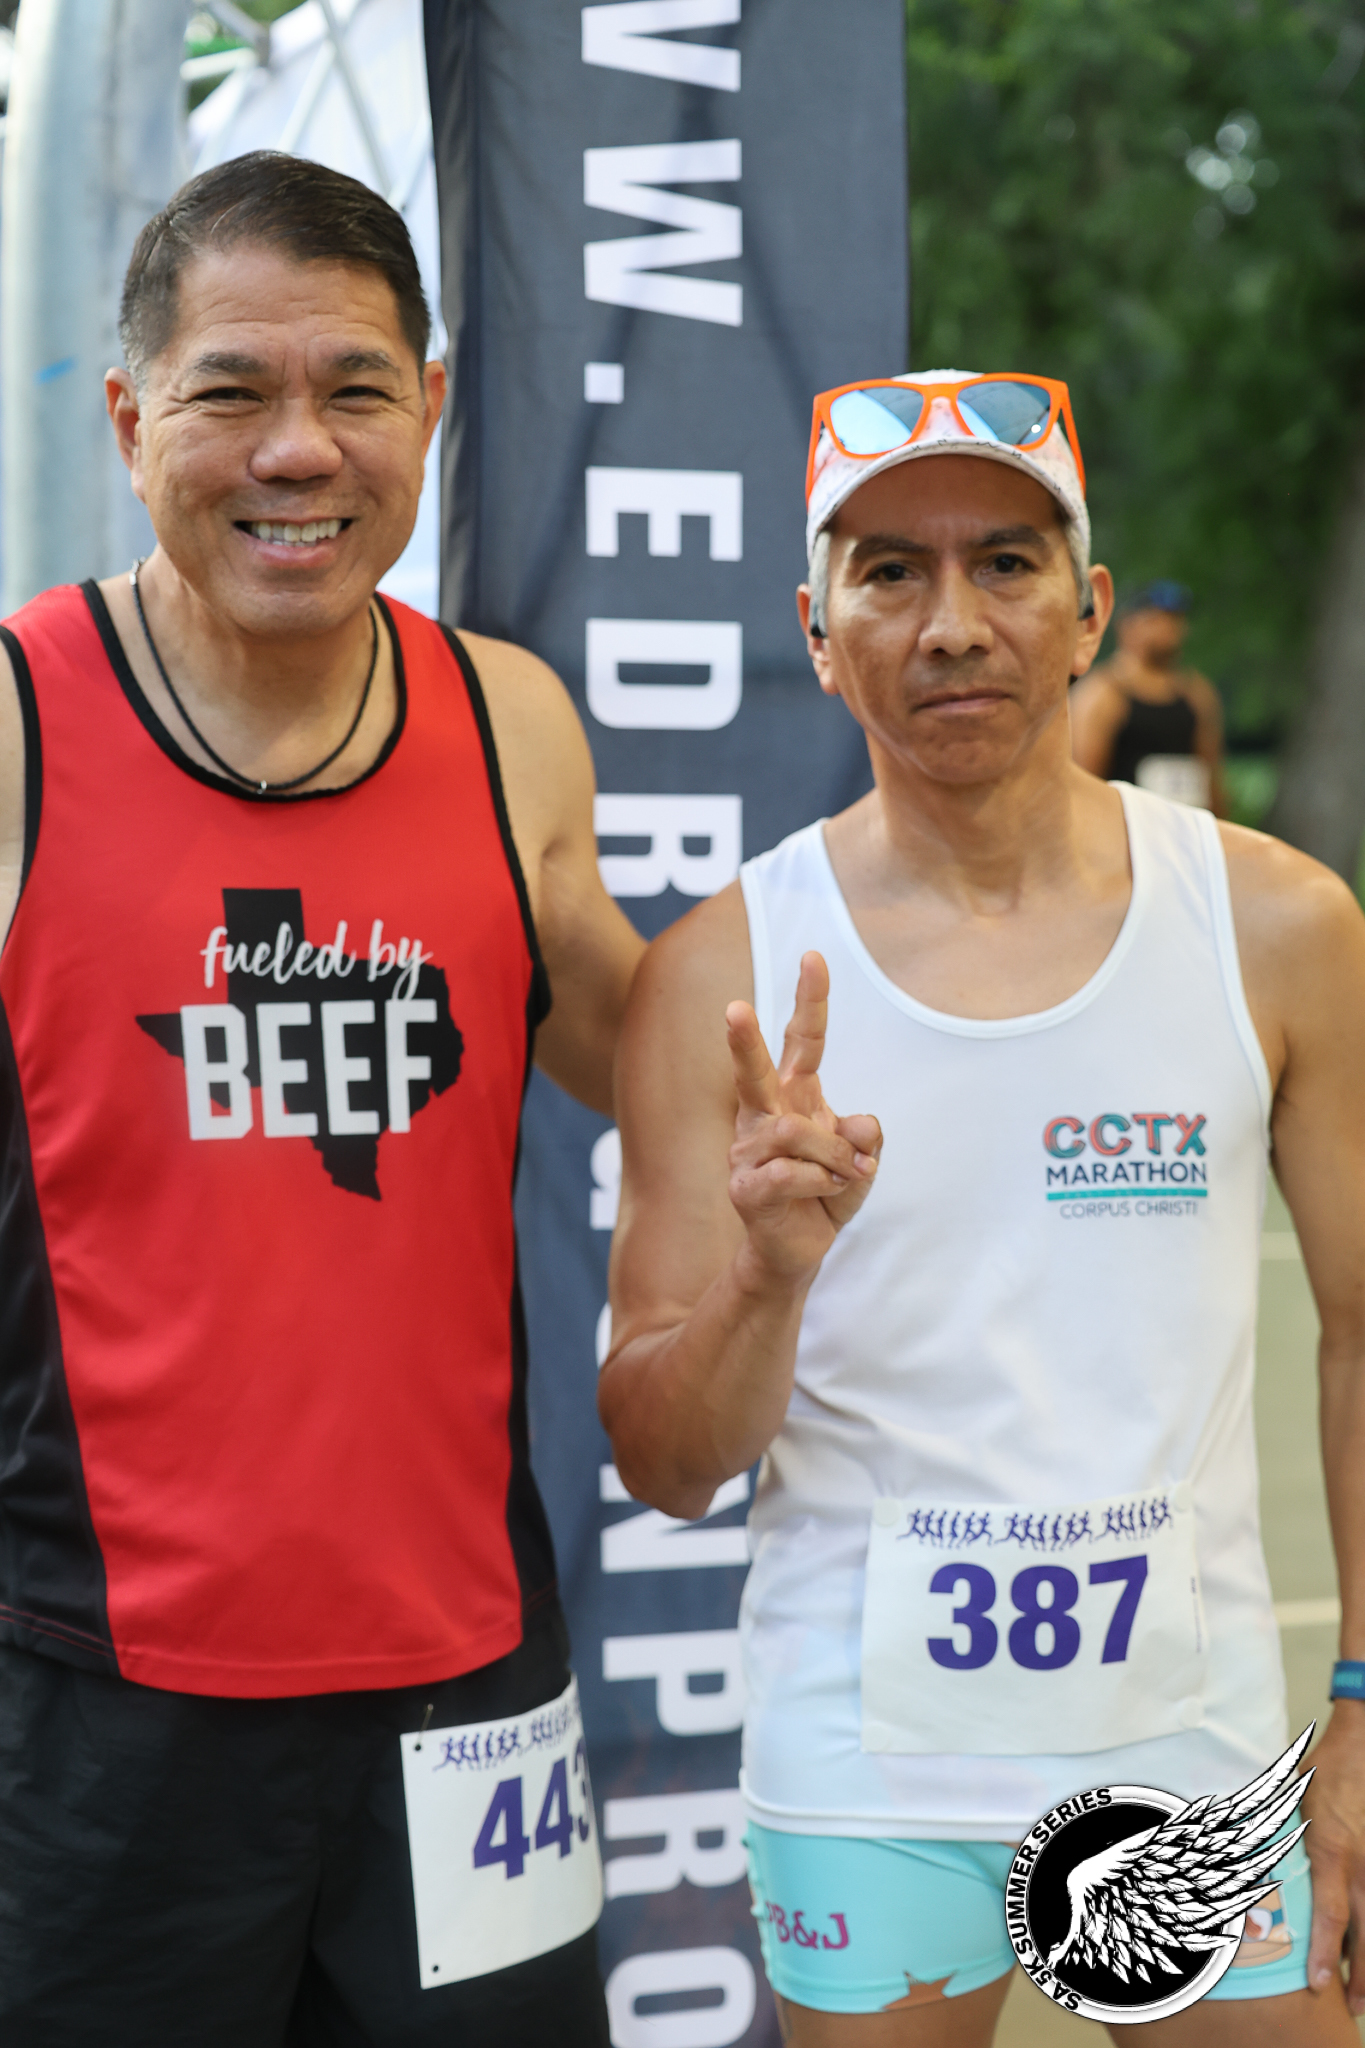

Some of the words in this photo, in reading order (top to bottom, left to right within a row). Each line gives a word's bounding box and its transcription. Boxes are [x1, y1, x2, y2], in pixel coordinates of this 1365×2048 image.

[200, 920, 356, 988] fueled
[368, 918, 433, 1001] by
[180, 999, 438, 1141] BEEF
[1043, 1113, 1207, 1159] CCTX
[1047, 1162, 1207, 1186] MARATHON
[1060, 1202, 1130, 1219] CORPUS
[1135, 1200, 1198, 1217] CHRISTI
[927, 1554, 1148, 1671] 387
